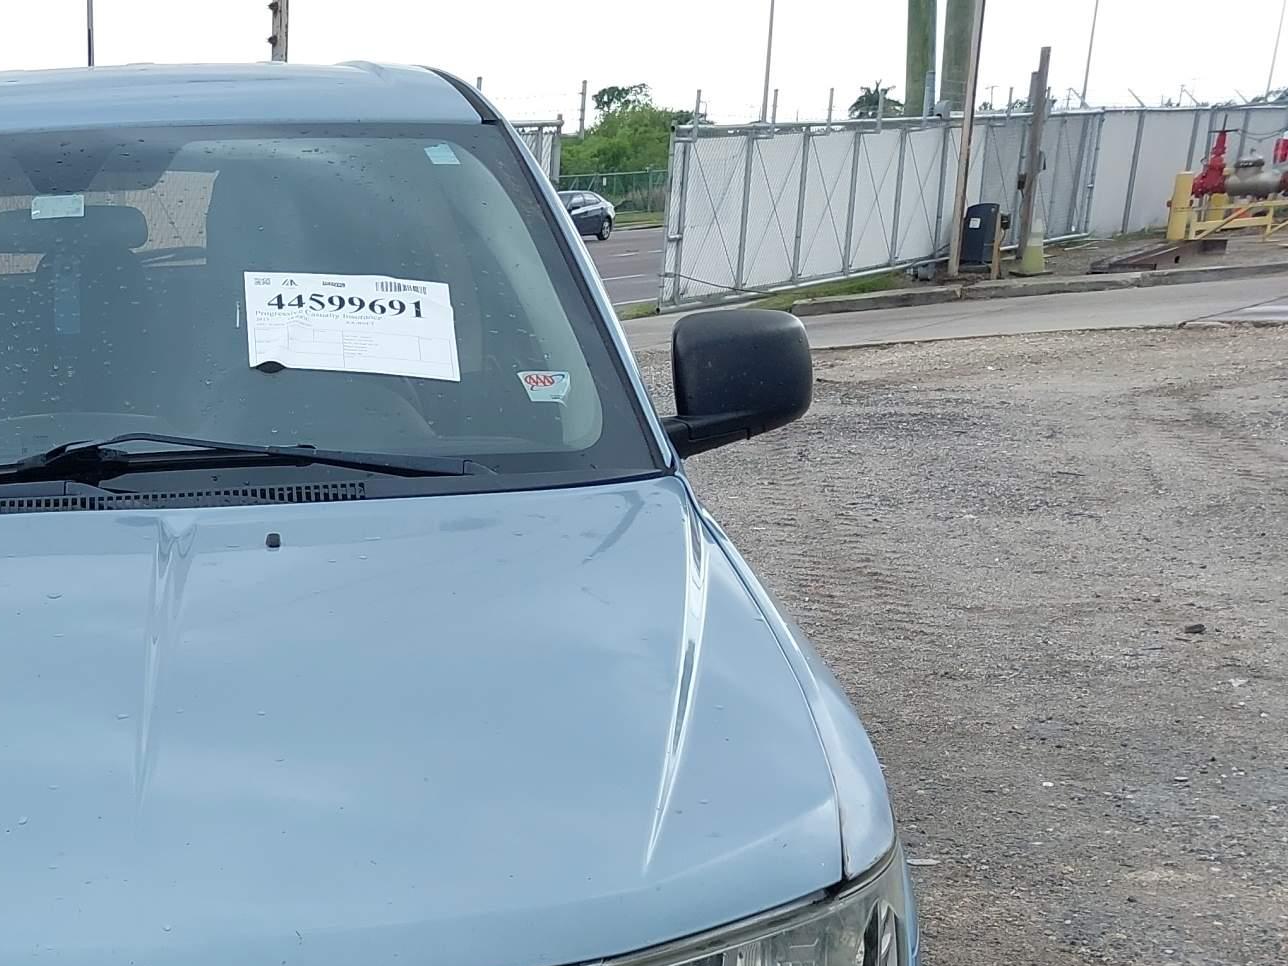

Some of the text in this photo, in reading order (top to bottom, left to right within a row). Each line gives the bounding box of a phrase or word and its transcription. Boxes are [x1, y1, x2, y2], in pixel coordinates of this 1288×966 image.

[267, 293, 424, 318] 44599691
[305, 309, 340, 321] Casualty
[343, 313, 383, 321] Insurance
[524, 374, 555, 387] AAA
